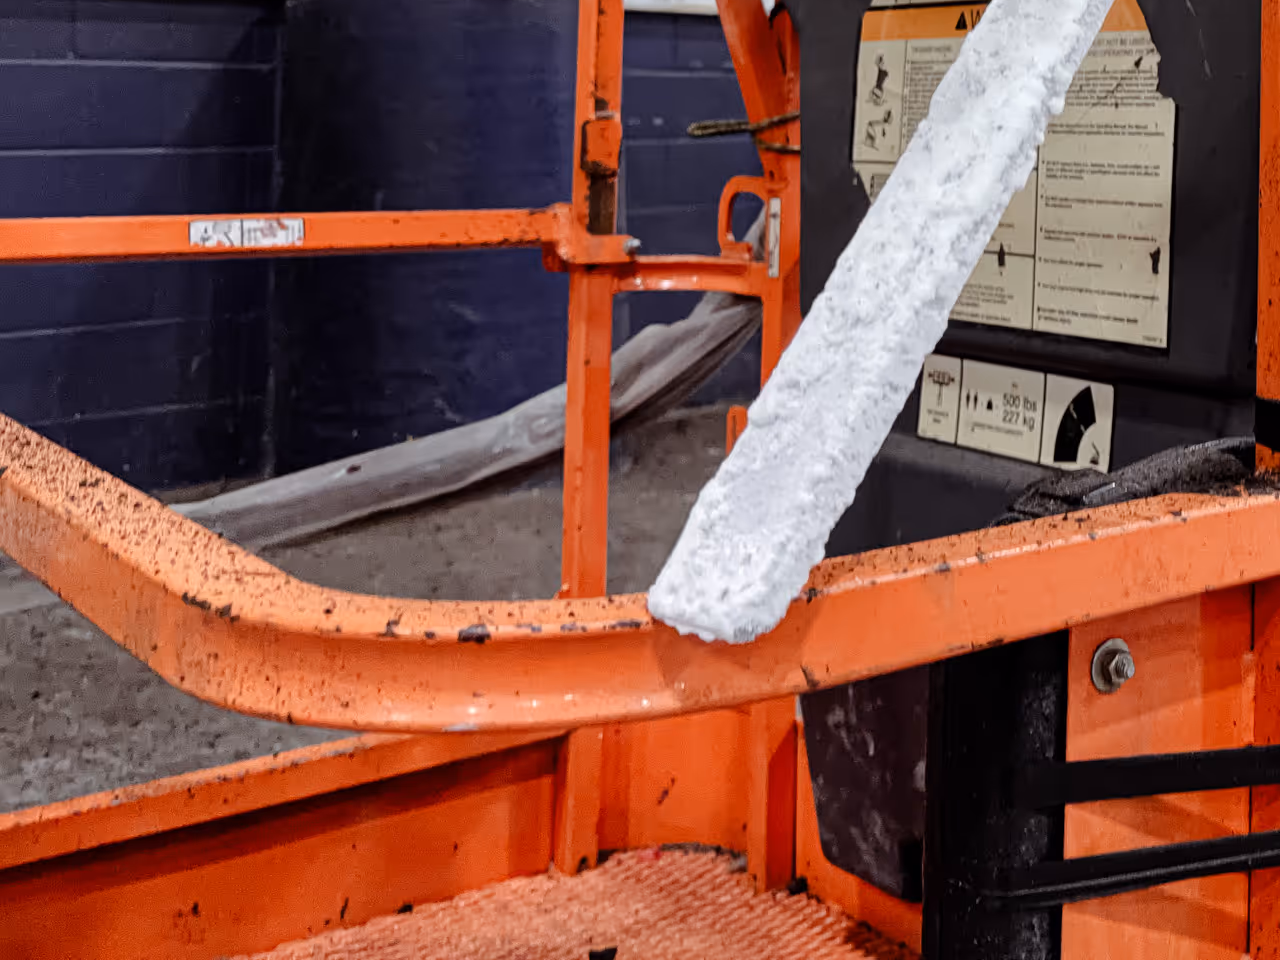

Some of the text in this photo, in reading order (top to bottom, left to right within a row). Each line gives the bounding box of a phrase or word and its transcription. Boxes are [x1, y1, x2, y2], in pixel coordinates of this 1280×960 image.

[1002, 392, 1038, 413] 500 lbs
[1002, 408, 1020, 426] 227
[1023, 414, 1036, 433] kg
